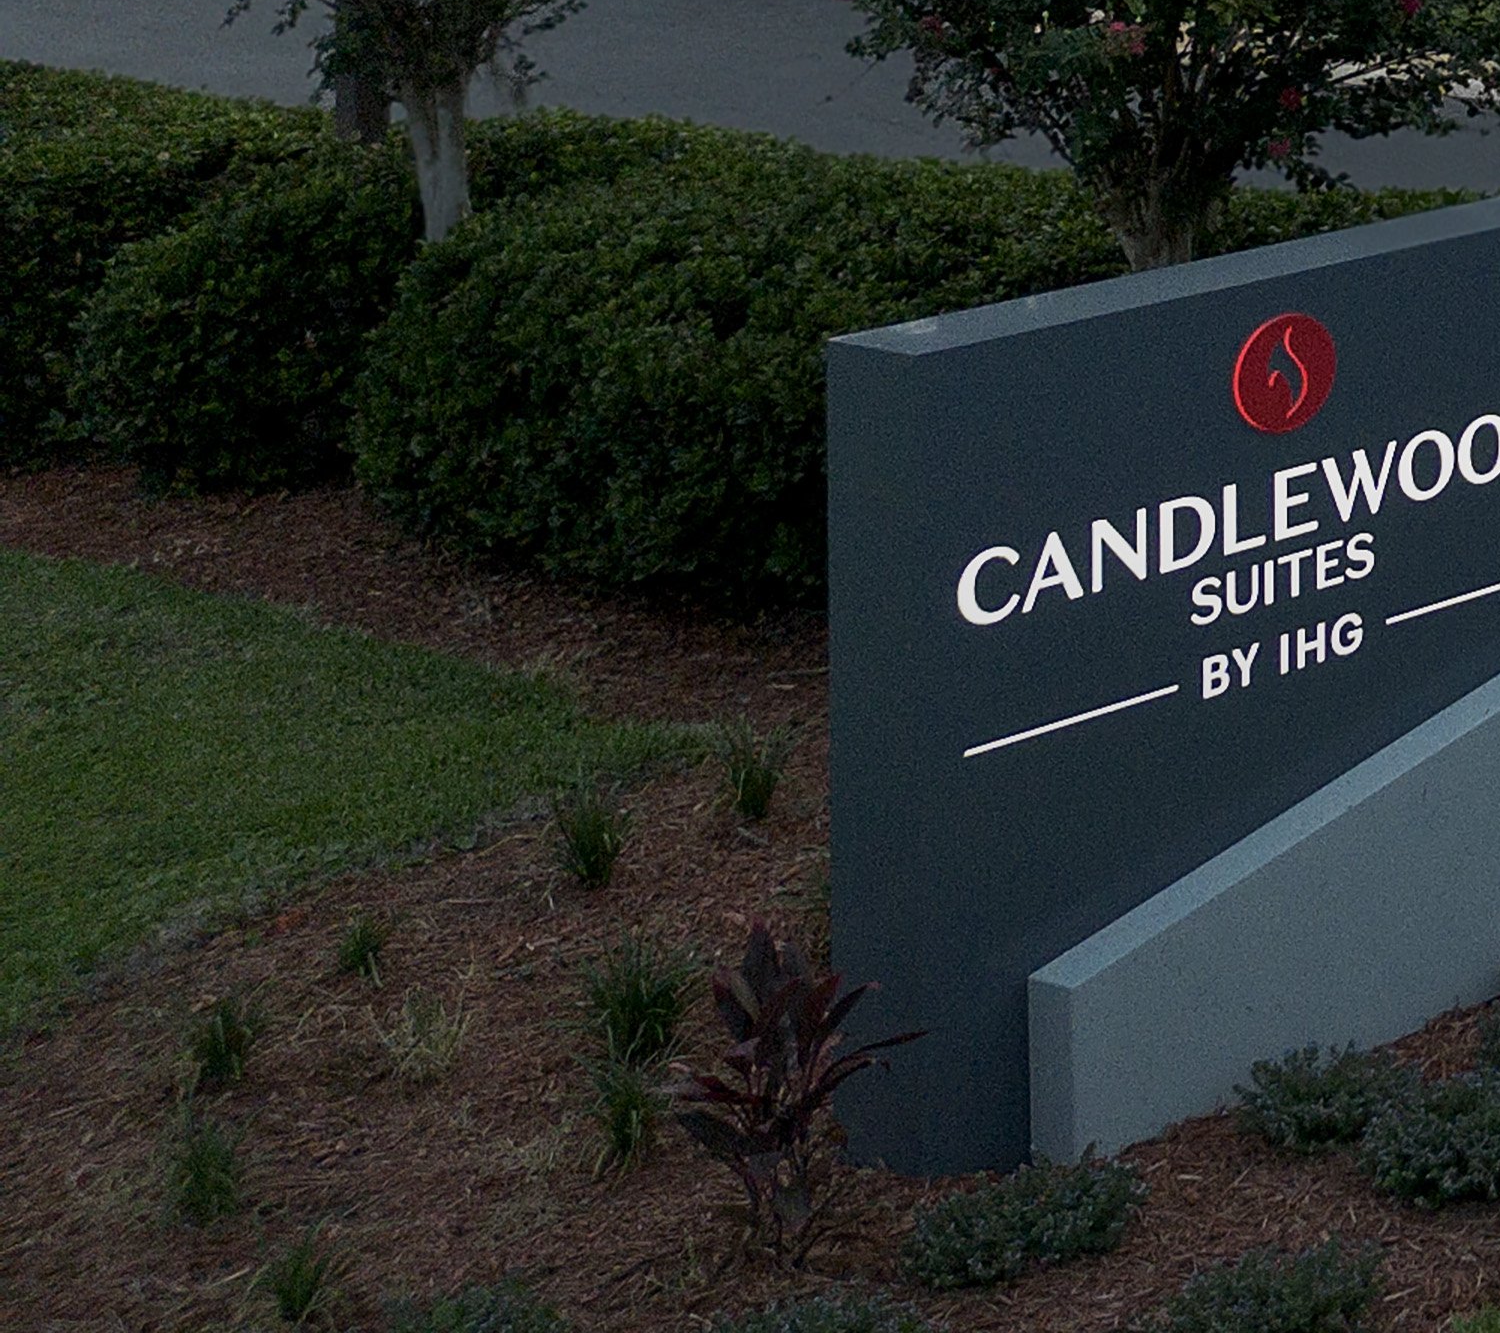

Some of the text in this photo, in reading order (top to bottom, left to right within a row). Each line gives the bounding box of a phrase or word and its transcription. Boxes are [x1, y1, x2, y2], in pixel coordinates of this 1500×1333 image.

[1189, 532, 1376, 627] SUITES
[1201, 612, 1365, 701] BY IHG
